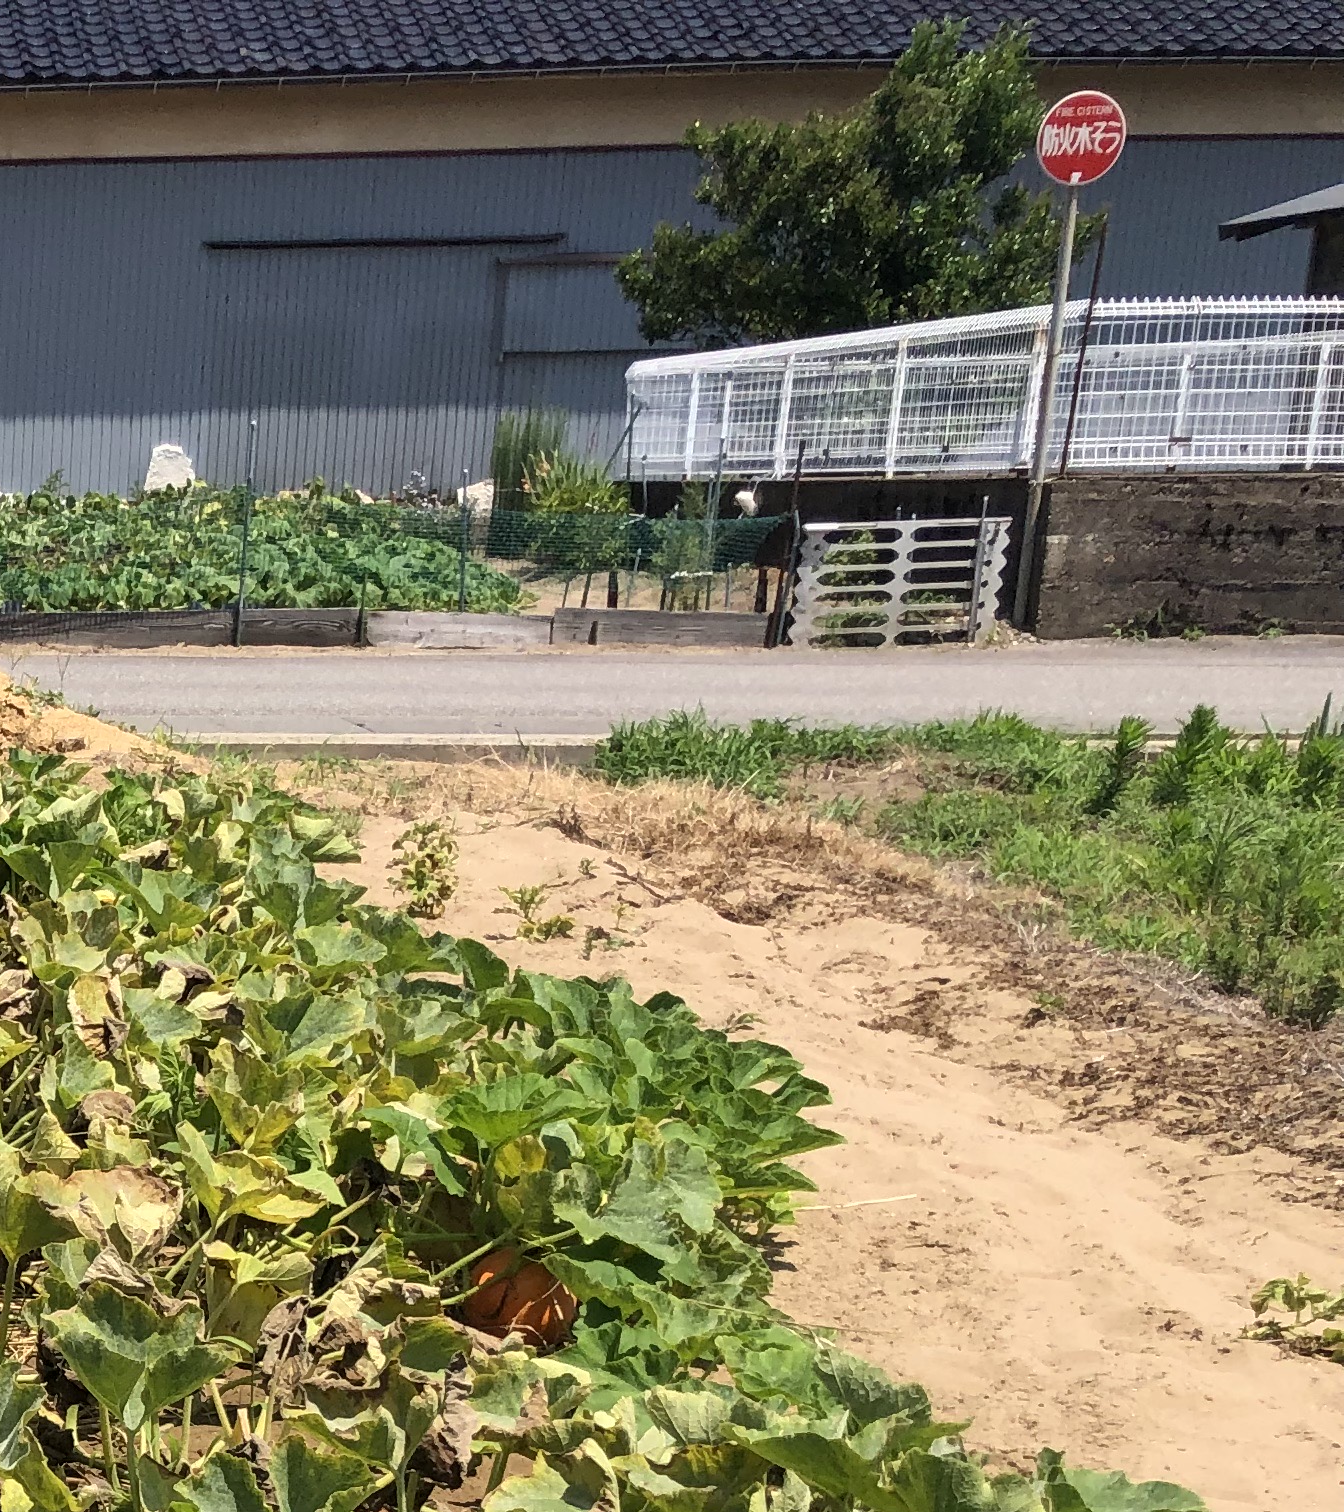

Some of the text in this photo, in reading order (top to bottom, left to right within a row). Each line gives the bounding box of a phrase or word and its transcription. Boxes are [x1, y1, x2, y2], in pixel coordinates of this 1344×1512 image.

[1055, 104, 1114, 117] FIRE CISTERN
[1041, 120, 1122, 156] 防火水そう
